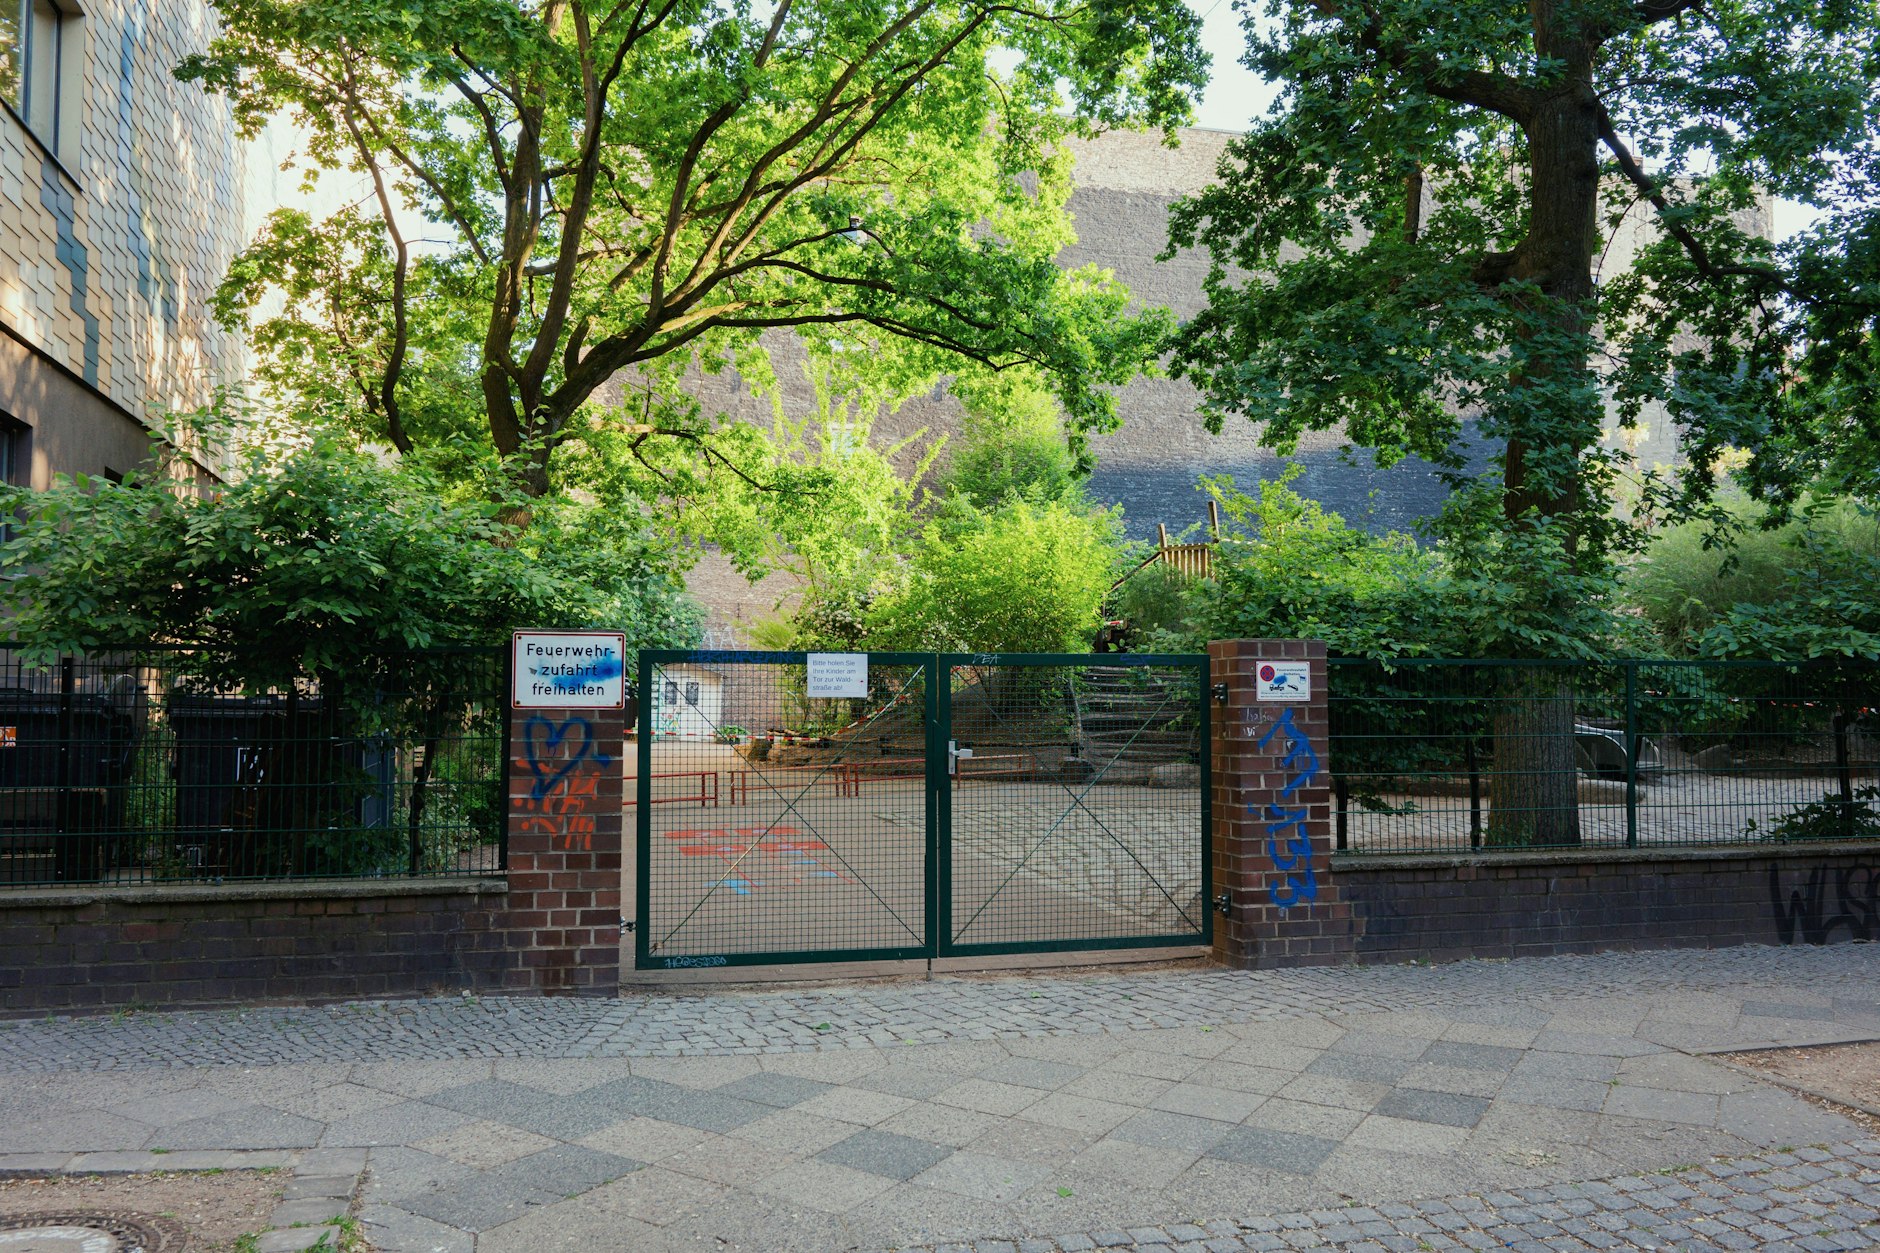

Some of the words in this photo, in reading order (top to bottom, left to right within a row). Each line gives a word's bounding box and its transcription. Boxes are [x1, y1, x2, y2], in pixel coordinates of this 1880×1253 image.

[527, 643, 616, 656] Feuerwehr-
[541, 663, 598, 676] zufahrt
[532, 682, 605, 696] freihalten
